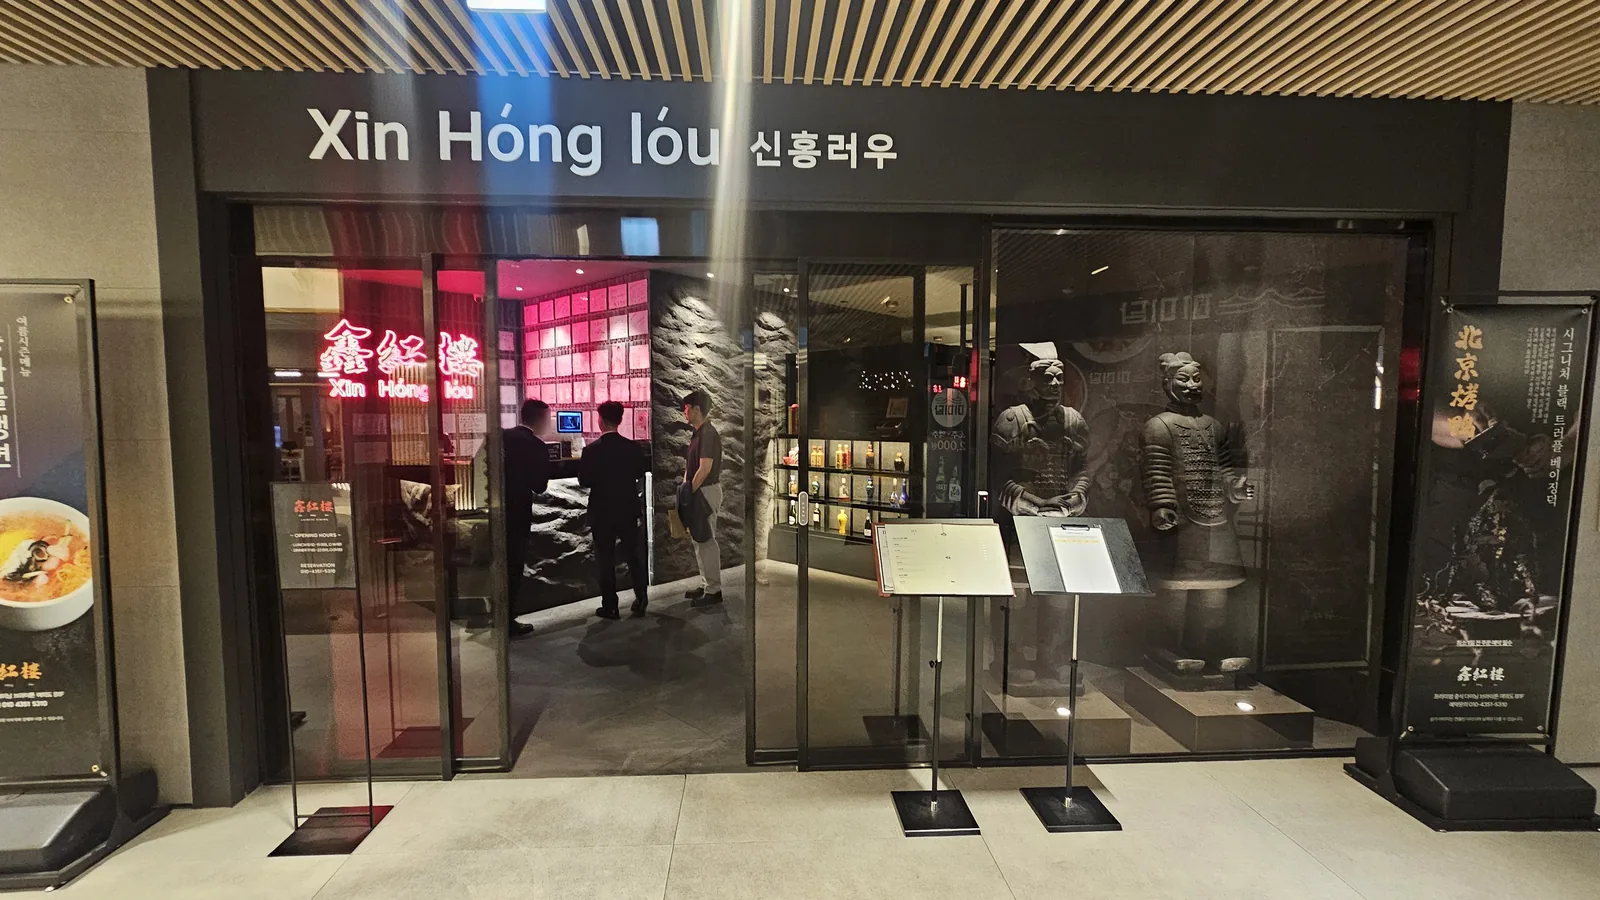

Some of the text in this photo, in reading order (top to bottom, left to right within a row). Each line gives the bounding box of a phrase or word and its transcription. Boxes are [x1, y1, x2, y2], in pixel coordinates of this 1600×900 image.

[306, 102, 720, 177] Xin Hóng lóu
[750, 130, 897, 169] 신홍러우
[329, 377, 473, 402] Xin Hóng lóu
[1546, 327, 1575, 508] 시그니처 블랙 트러플 베이징덕
